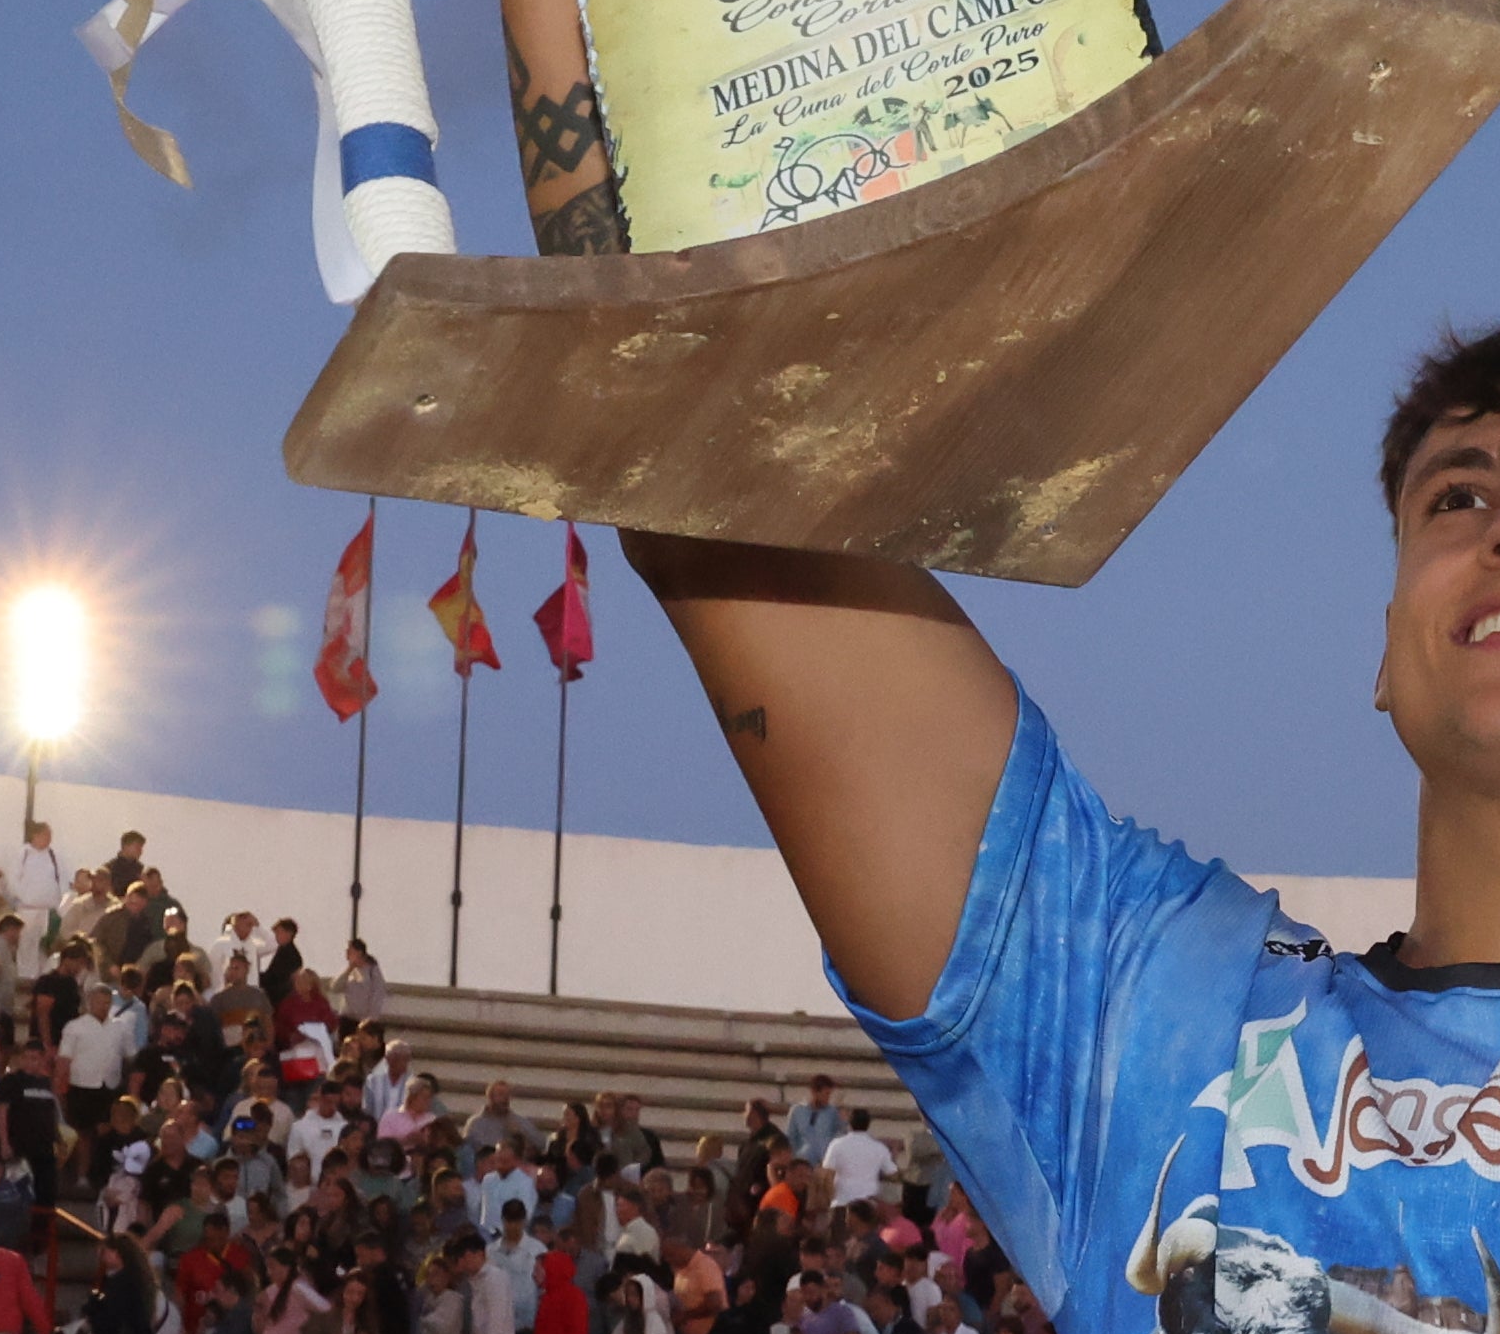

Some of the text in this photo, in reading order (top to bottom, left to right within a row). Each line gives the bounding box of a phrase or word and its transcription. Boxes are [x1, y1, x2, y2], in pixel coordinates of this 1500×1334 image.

[710, 45, 847, 117] MEDINA
[852, 18, 920, 67] DEL
[721, 20, 1049, 149] La Cuna del Corte Puro
[944, 48, 1041, 99] 2025
